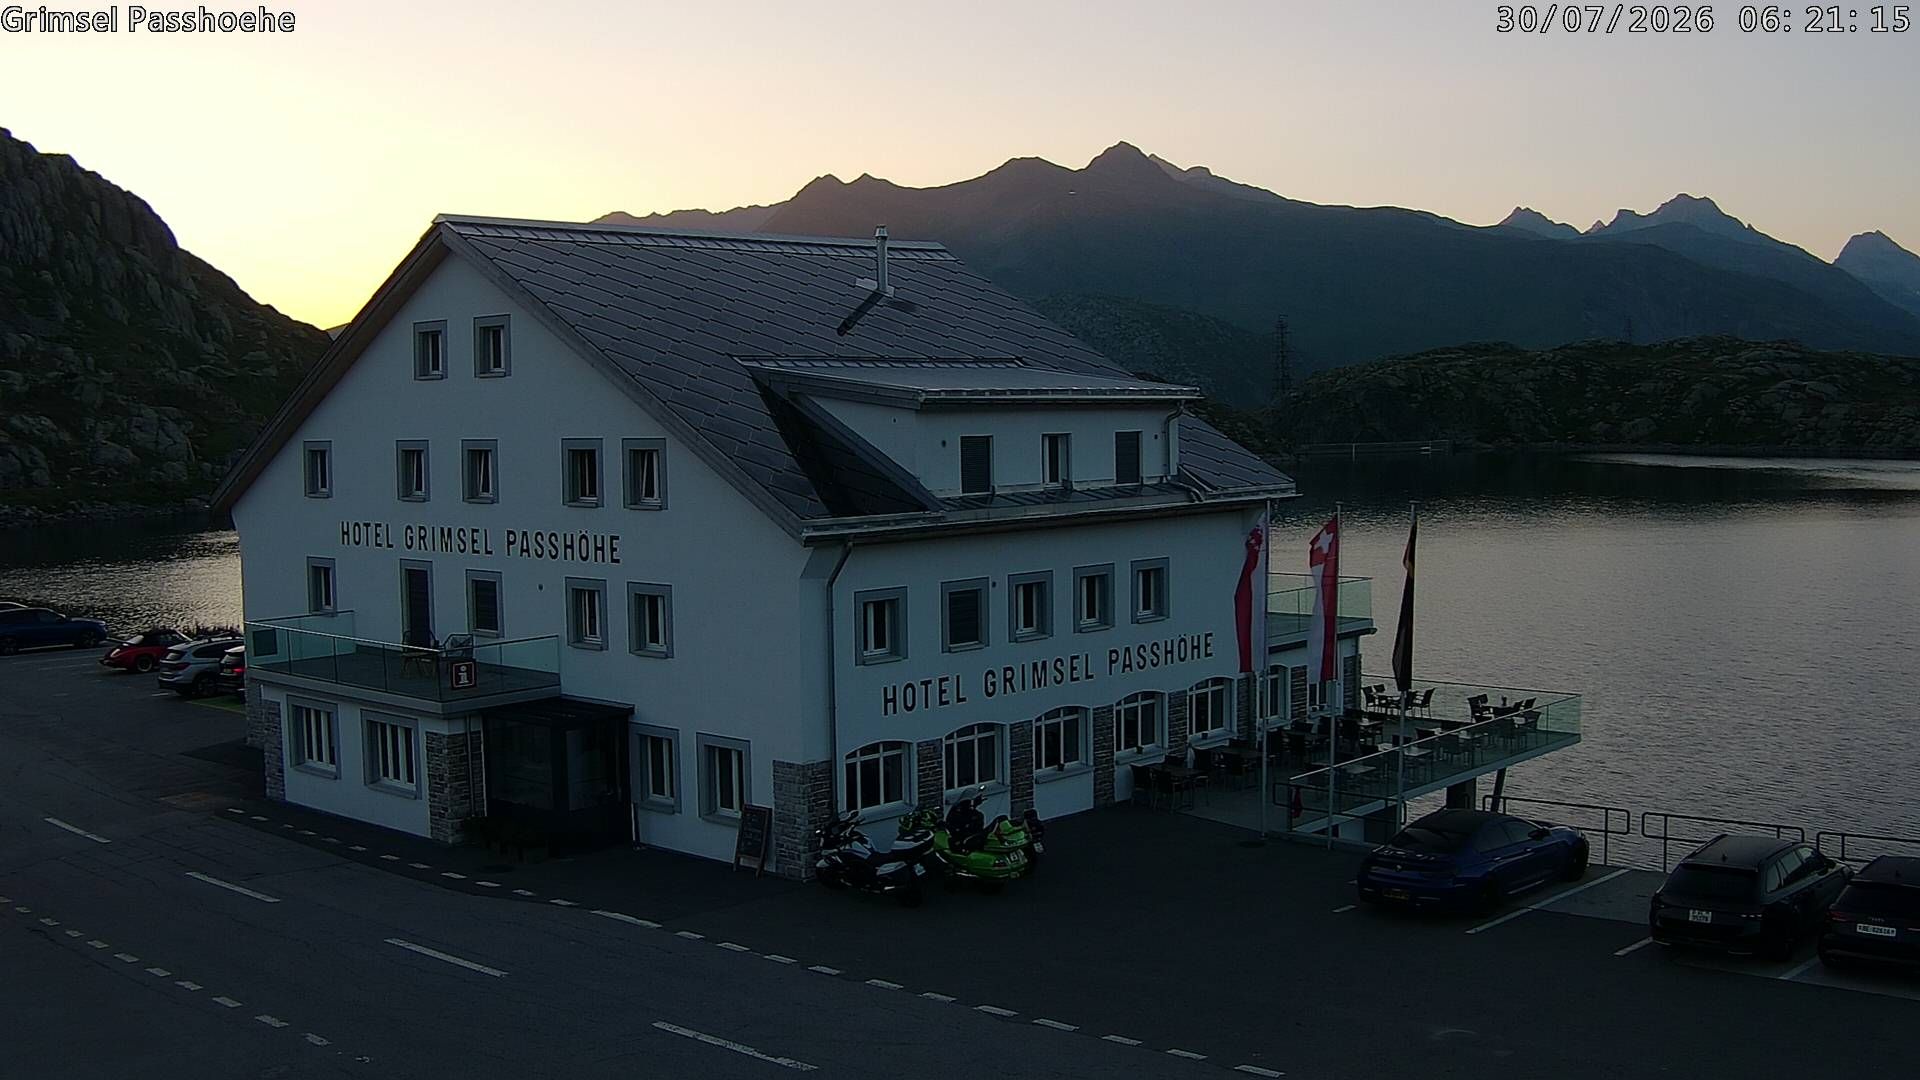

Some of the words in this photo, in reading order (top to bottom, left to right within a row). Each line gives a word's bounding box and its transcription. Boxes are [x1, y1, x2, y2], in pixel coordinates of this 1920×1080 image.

[341, 521, 394, 548] HOTEL
[404, 525, 493, 555] GRIMSEL
[506, 529, 621, 564] PASSHÖHE
[882, 675, 967, 716] HOTEL
[984, 653, 1095, 698] GRIMSEL
[1108, 632, 1214, 675] PASSHÖHE
